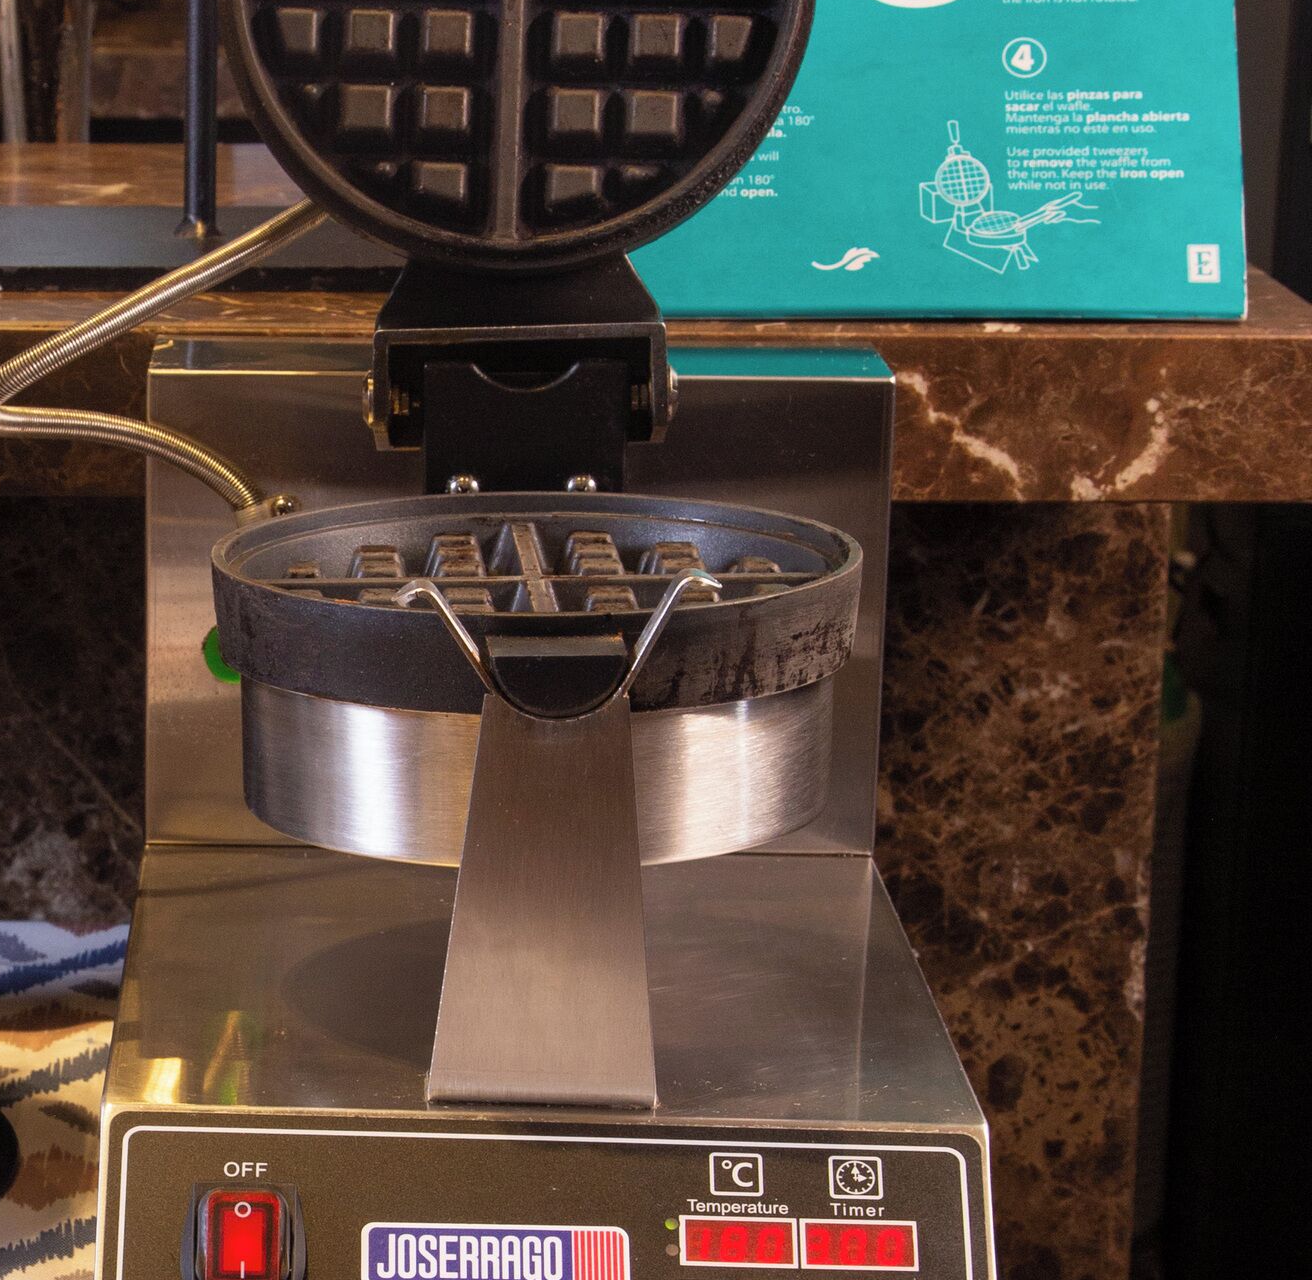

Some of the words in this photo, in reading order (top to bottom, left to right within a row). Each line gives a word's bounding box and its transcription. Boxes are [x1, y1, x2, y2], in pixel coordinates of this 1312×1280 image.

[1010, 44, 1035, 71] 4
[1004, 90, 1044, 101] Utilice
[1047, 89, 1064, 100] las
[1066, 89, 1110, 102] pinzas
[1112, 90, 1143, 102] para
[1005, 103, 1039, 112] sacar
[1042, 101, 1054, 112] el
[788, 115, 815, 126] 180°
[1005, 112, 1069, 125] Mantenga
[1072, 112, 1083, 122] la
[1086, 111, 1139, 124] plancha
[1142, 111, 1190, 122] abierta
[1005, 124, 1060, 135] mientras
[1064, 125, 1080, 134] no
[1112, 124, 1127, 133] en
[1131, 124, 1156, 133] uso.
[758, 151, 779, 161] will
[1006, 147, 1030, 157] Use
[1033, 146, 1089, 159] provided
[1093, 147, 1148, 157] tweezers
[1007, 158, 1020, 168] to
[1023, 158, 1073, 168] remove
[1076, 157, 1097, 167] the
[1100, 156, 1138, 167] waffle
[1140, 156, 1171, 167] from
[749, 175, 775, 185] 180°
[1007, 169, 1028, 180] the
[1031, 169, 1059, 179] iron.
[1062, 169, 1093, 181] Keep
[1096, 168, 1117, 179] the
[1120, 168, 1147, 179] iron
[1150, 169, 1185, 181] open
[1008, 180, 1042, 191] while
[1045, 180, 1066, 190] not
[1070, 180, 1081, 190] in
[1085, 181, 1109, 190] use.
[718, 187, 737, 197] nd
[740, 188, 778, 199] open.
[223, 1160, 269, 1178] OFF
[687, 1199, 789, 1216] Temperature
[830, 1203, 885, 1217] Timer
